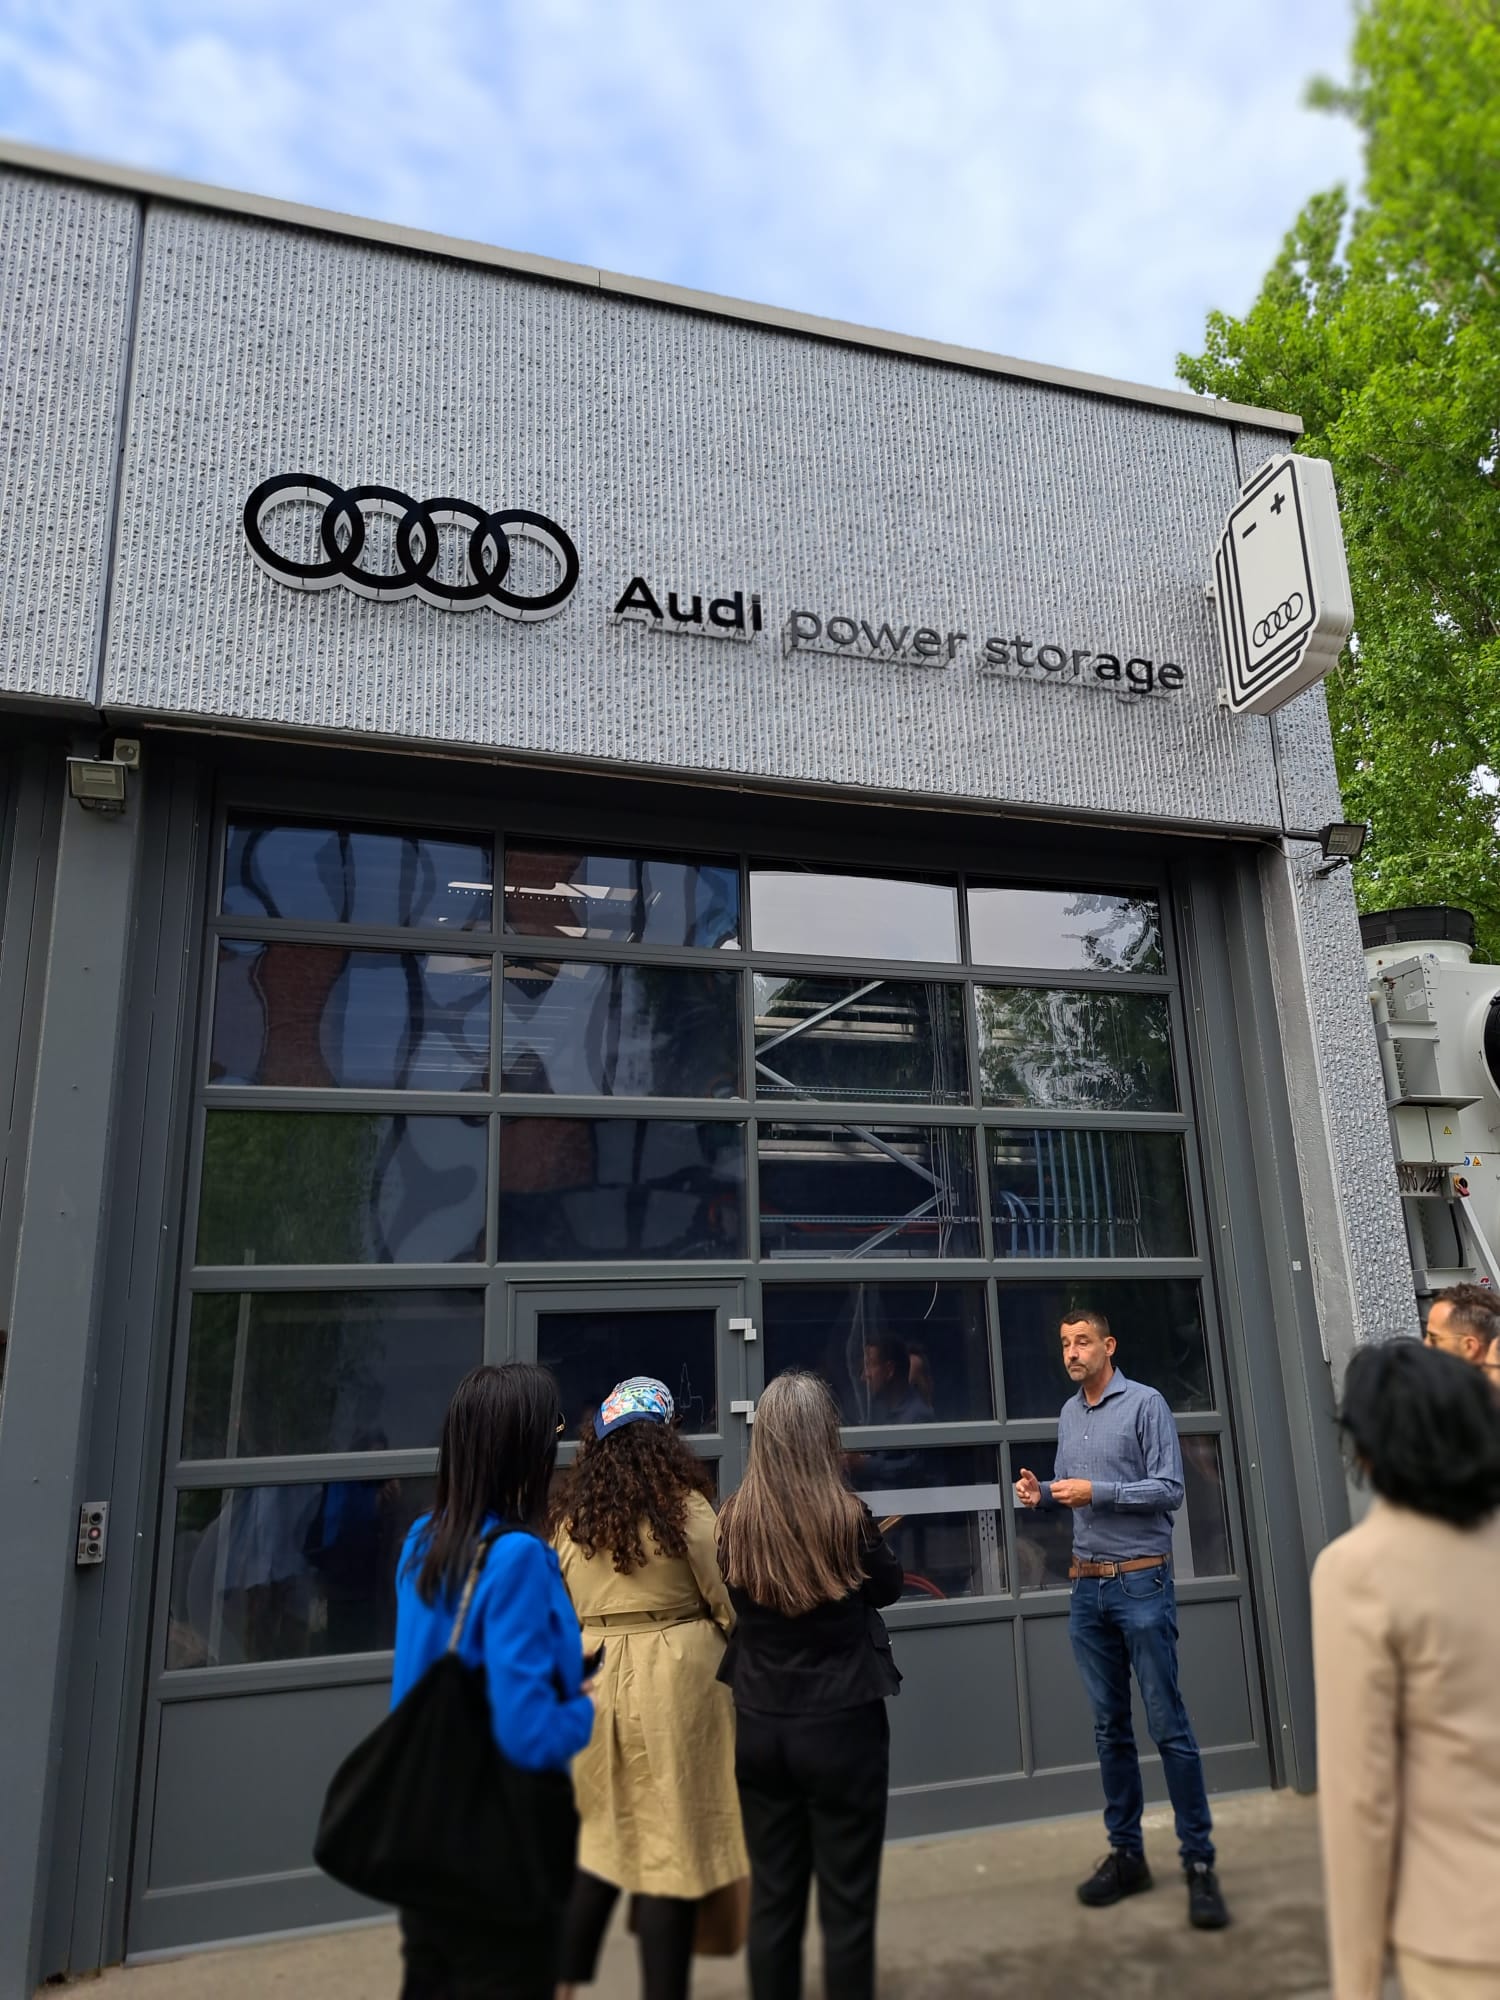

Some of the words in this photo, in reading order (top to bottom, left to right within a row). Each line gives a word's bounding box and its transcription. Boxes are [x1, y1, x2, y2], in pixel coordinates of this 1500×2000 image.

[613, 576, 763, 632] Audi
[788, 609, 968, 660] power
[984, 633, 1185, 694] storage
